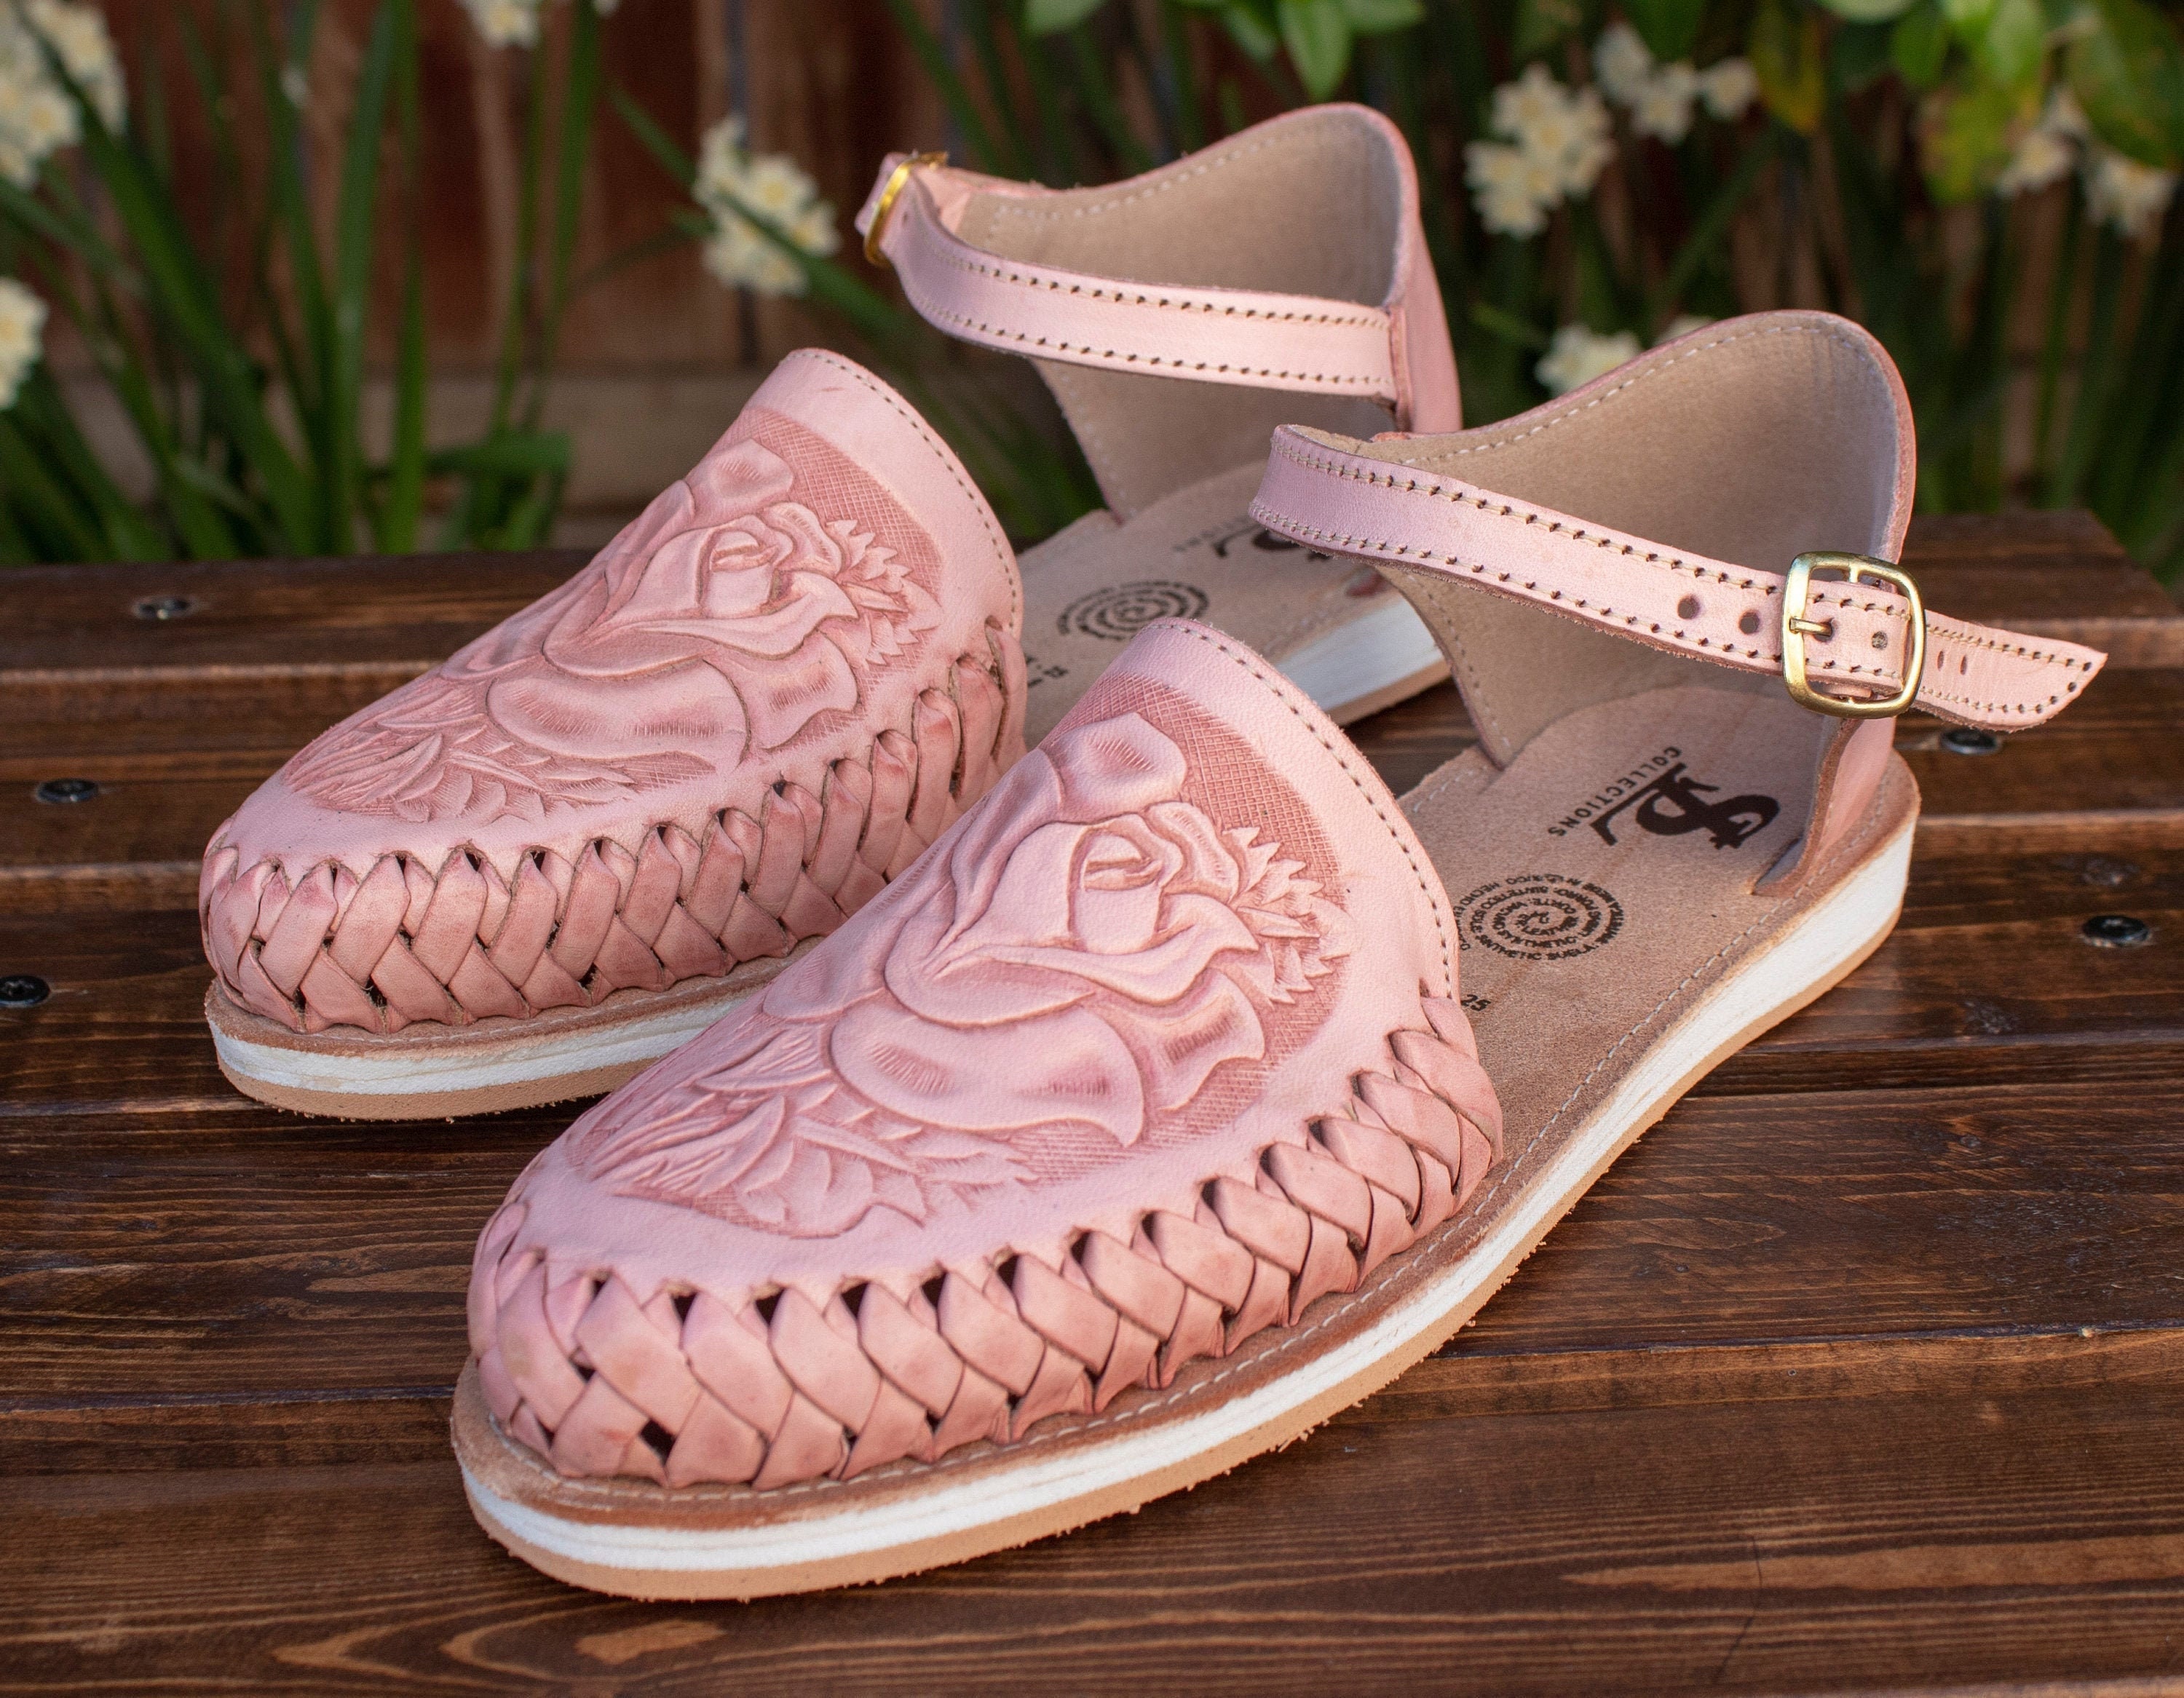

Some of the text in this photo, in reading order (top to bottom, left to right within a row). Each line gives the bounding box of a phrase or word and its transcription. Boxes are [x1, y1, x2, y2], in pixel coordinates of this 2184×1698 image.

[1547, 745, 1682, 837] COLLECTIONS
[1460, 882, 1501, 905] HECHO
[1528, 897, 1577, 914] CORTE:
[1460, 993, 1491, 1012] 25
